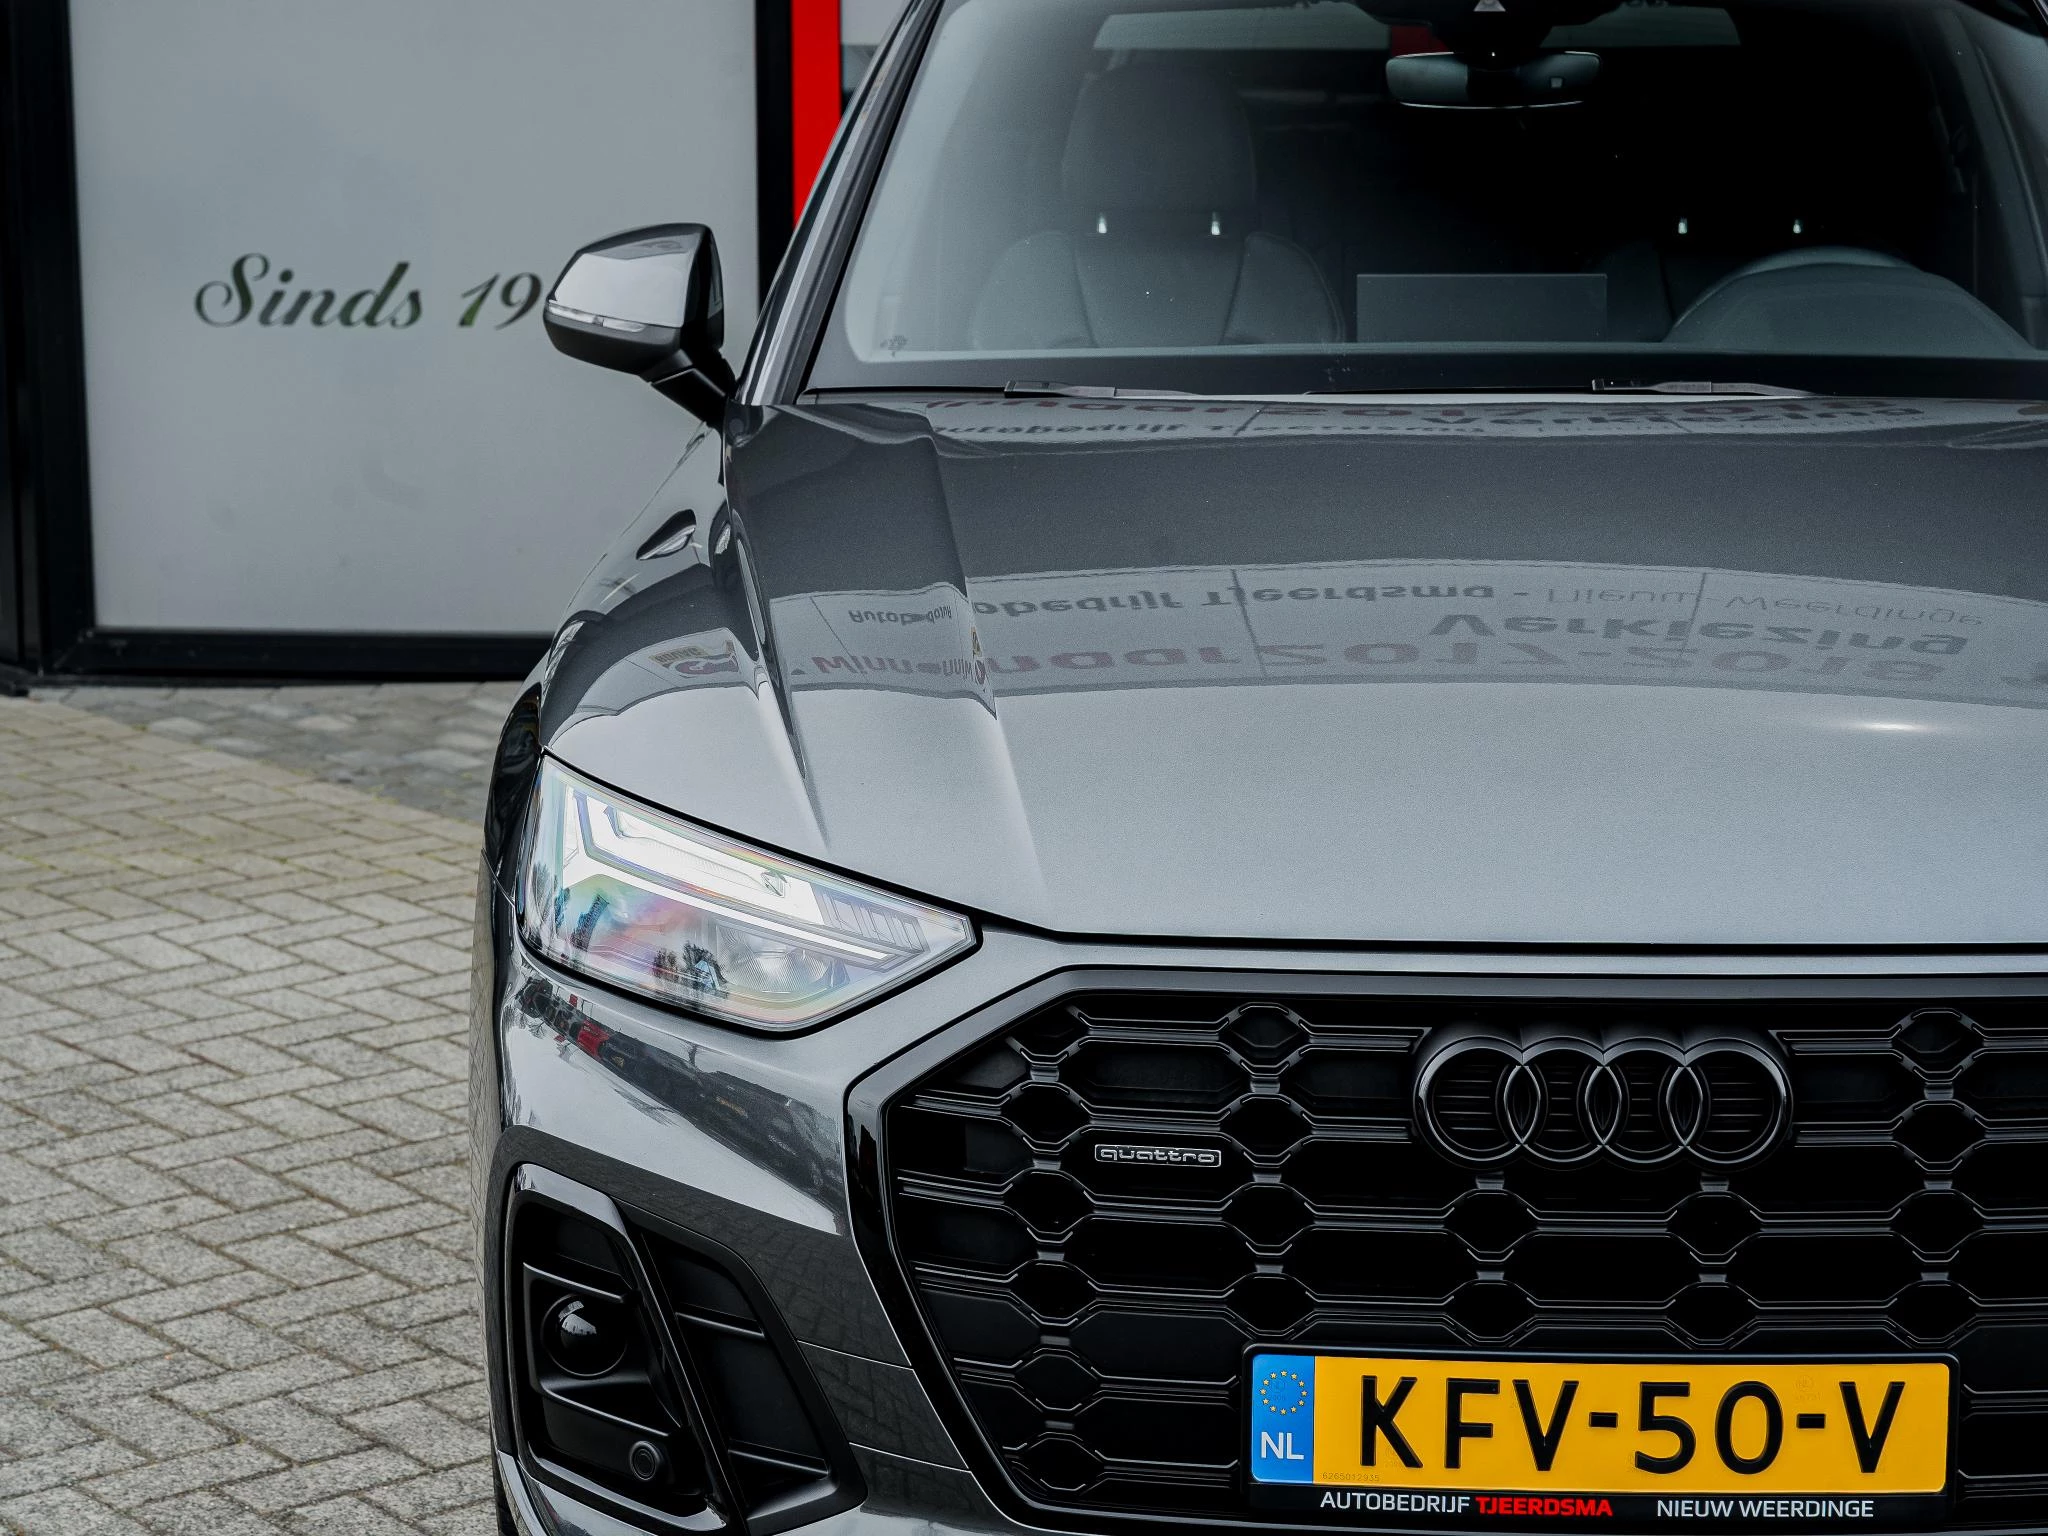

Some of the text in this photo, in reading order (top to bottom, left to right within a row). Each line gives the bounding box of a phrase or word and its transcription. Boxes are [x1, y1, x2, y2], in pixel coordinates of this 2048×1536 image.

[194, 252, 542, 331] Sinds 19
[1100, 1148, 1215, 1163] quattro
[1360, 1374, 1907, 1475] KFV-50-V
[1260, 1431, 1305, 1460] NL
[1320, 1491, 1874, 1519] AUTOBEDRIJF TJEERDSMA NIEUW WEERDINGE
